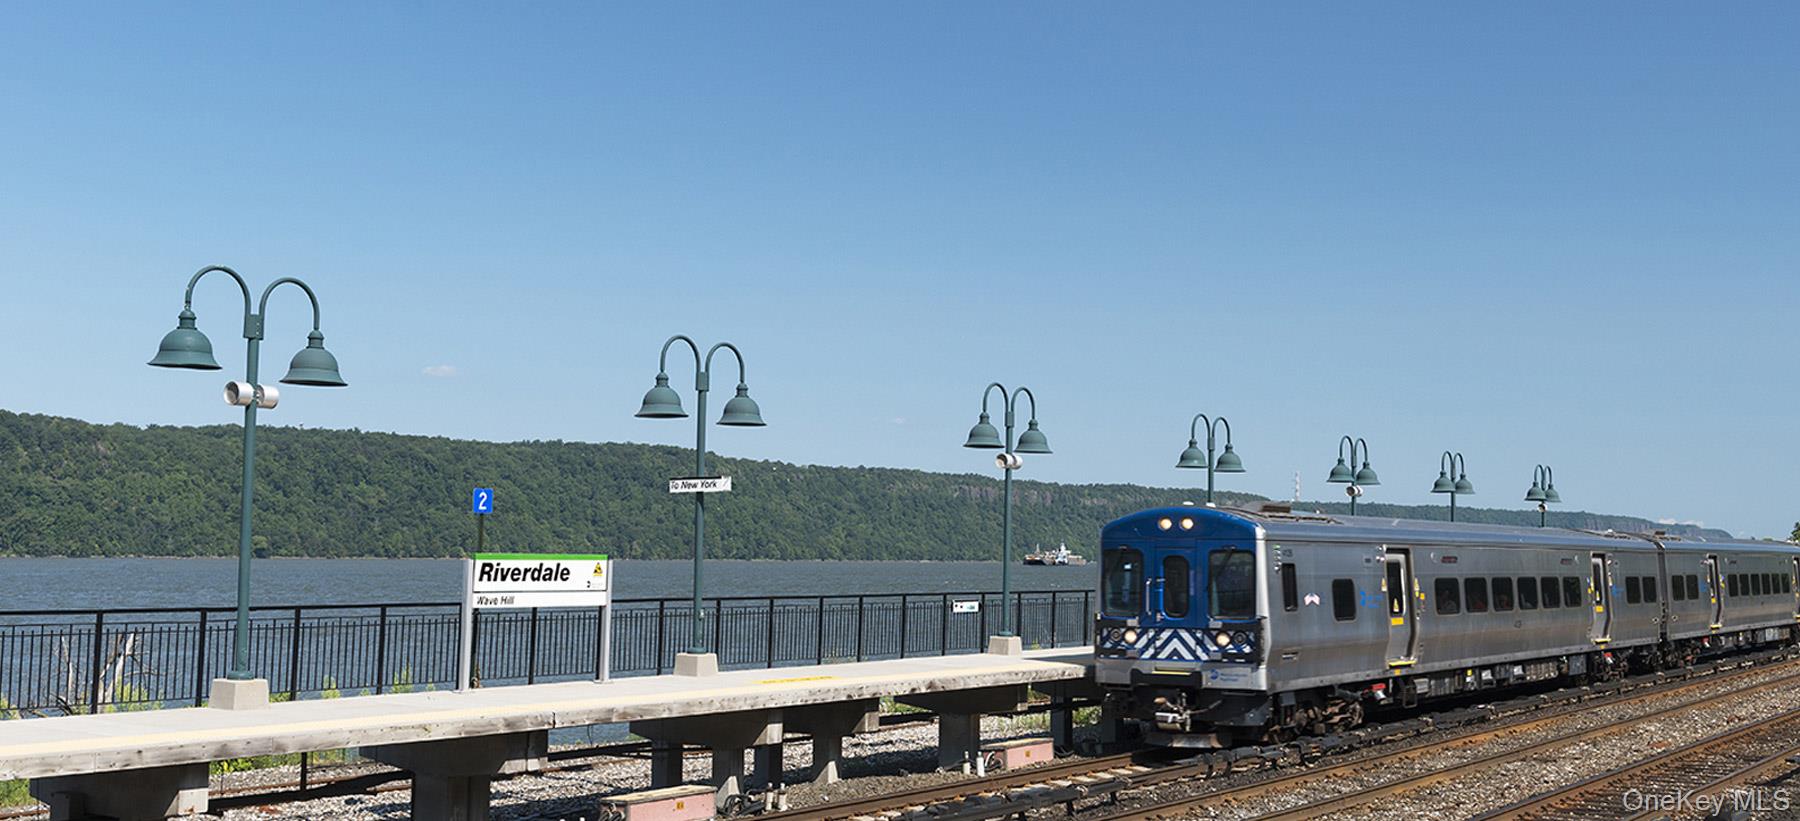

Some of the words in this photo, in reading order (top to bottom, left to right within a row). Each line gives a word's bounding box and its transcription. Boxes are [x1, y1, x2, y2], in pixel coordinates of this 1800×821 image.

[671, 481, 679, 489] To
[681, 481, 698, 489] New
[700, 480, 717, 489] York
[478, 492, 487, 510] 2
[478, 562, 571, 582] Riverdale
[477, 596, 498, 605] Wave
[500, 595, 515, 604] Hill
